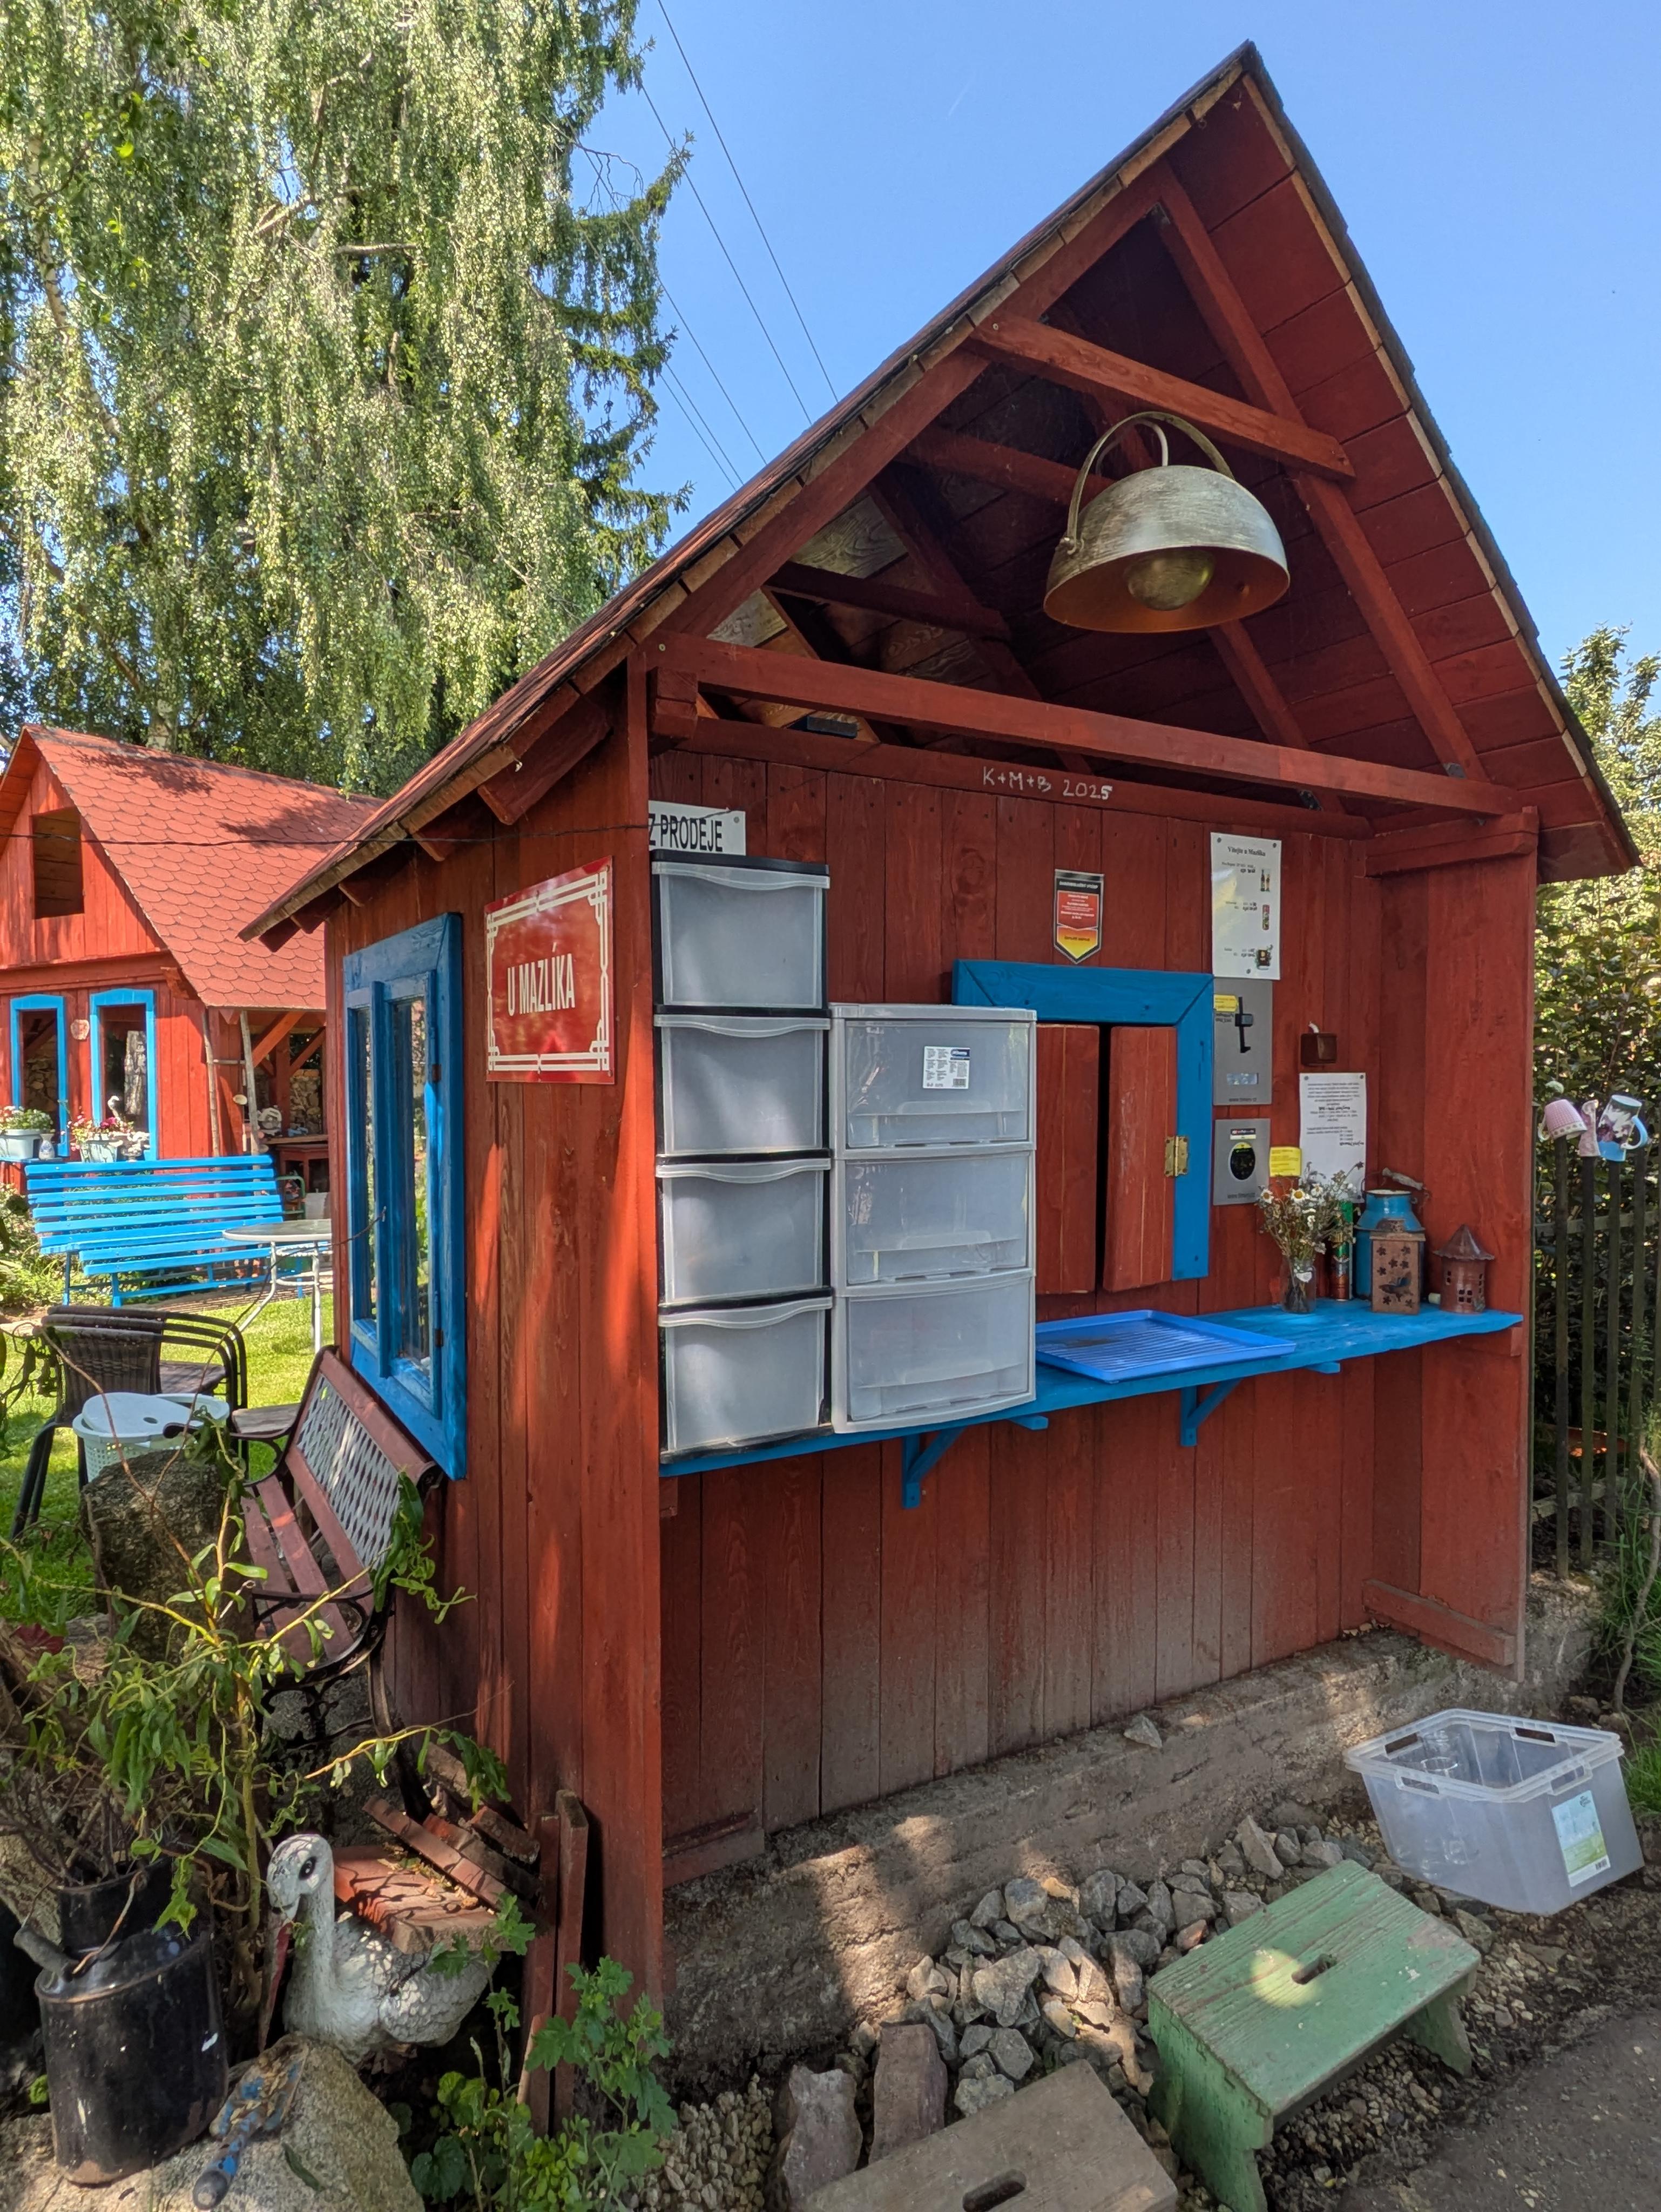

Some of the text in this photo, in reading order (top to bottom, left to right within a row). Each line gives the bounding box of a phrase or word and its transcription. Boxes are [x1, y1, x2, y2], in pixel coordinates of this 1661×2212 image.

[1063, 779, 1113, 800] 2025
[660, 814, 723, 852] PRODEJE
[507, 941, 576, 1016] U MAZLÍKA
